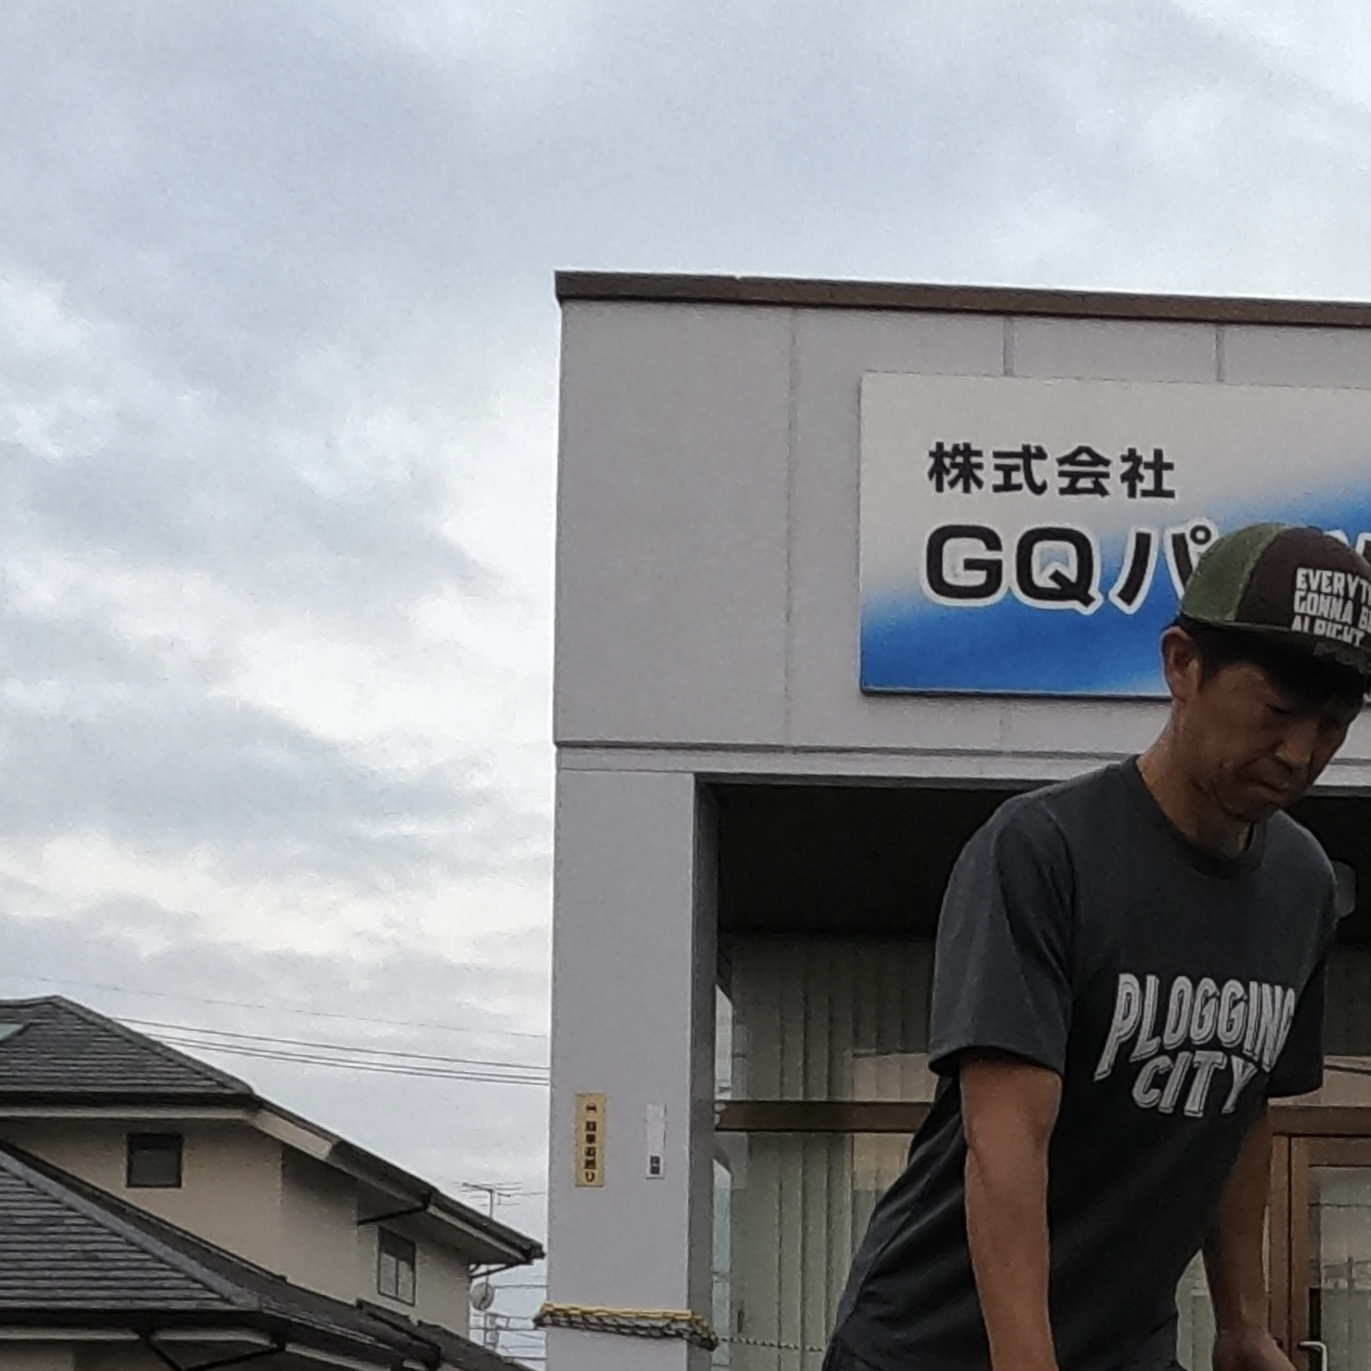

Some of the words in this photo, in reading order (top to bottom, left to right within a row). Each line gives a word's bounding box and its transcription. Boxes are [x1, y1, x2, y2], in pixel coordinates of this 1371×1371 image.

[928, 441, 1176, 499] 株式会社
[1293, 590, 1354, 626] GONNA
[1131, 1050, 1258, 1118] CITY
